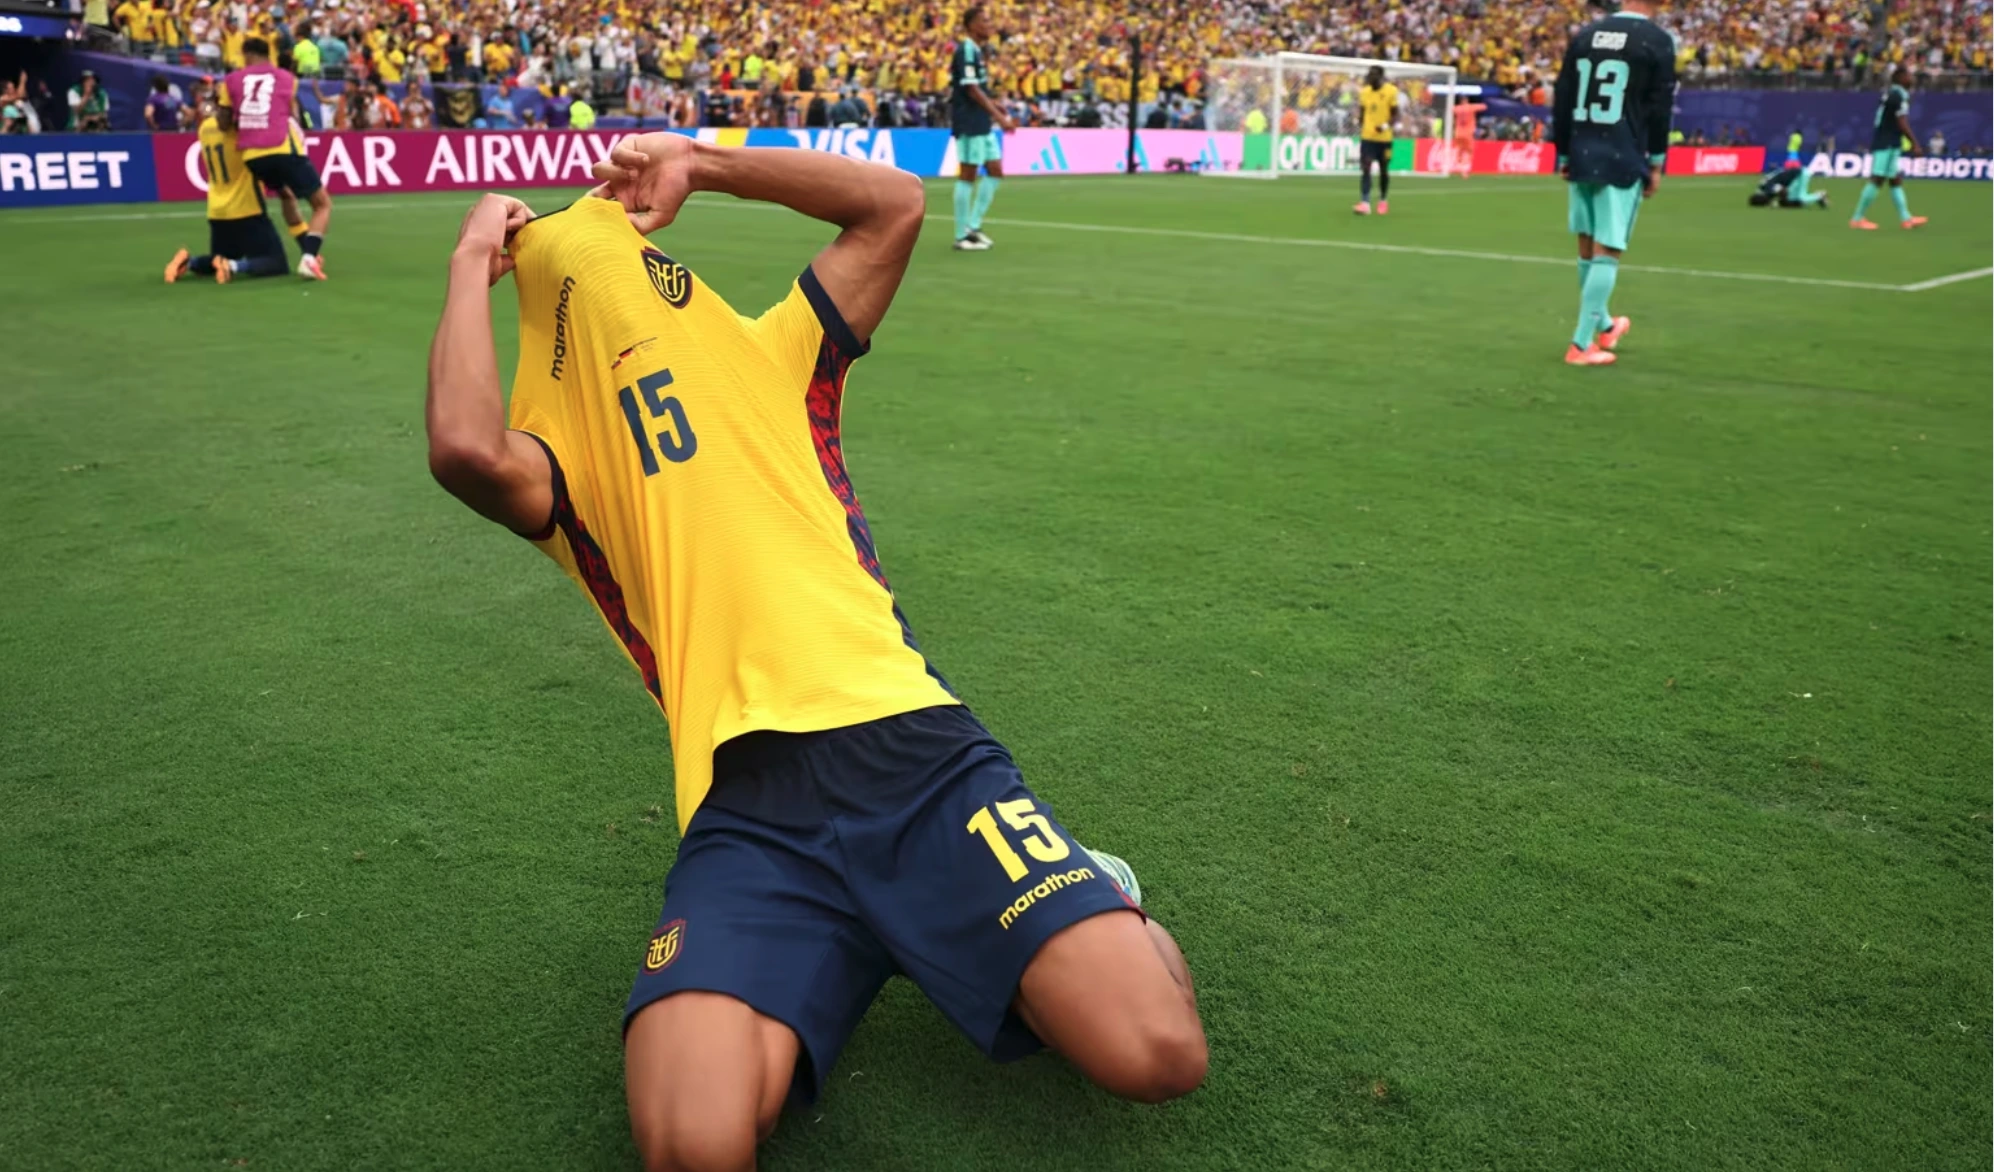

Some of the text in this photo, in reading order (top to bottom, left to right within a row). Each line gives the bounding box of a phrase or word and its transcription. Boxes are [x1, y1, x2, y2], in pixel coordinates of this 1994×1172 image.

[1572, 58, 1630, 124] 13
[0, 151, 130, 191] REET
[205, 143, 230, 185] 11
[425, 133, 641, 184] AIRWAY
[787, 129, 897, 168] VISA
[1280, 136, 1379, 169] aram
[550, 275, 576, 381] marathon
[618, 368, 698, 477] 15
[966, 798, 1070, 883] 15
[998, 867, 1095, 929] marathon
